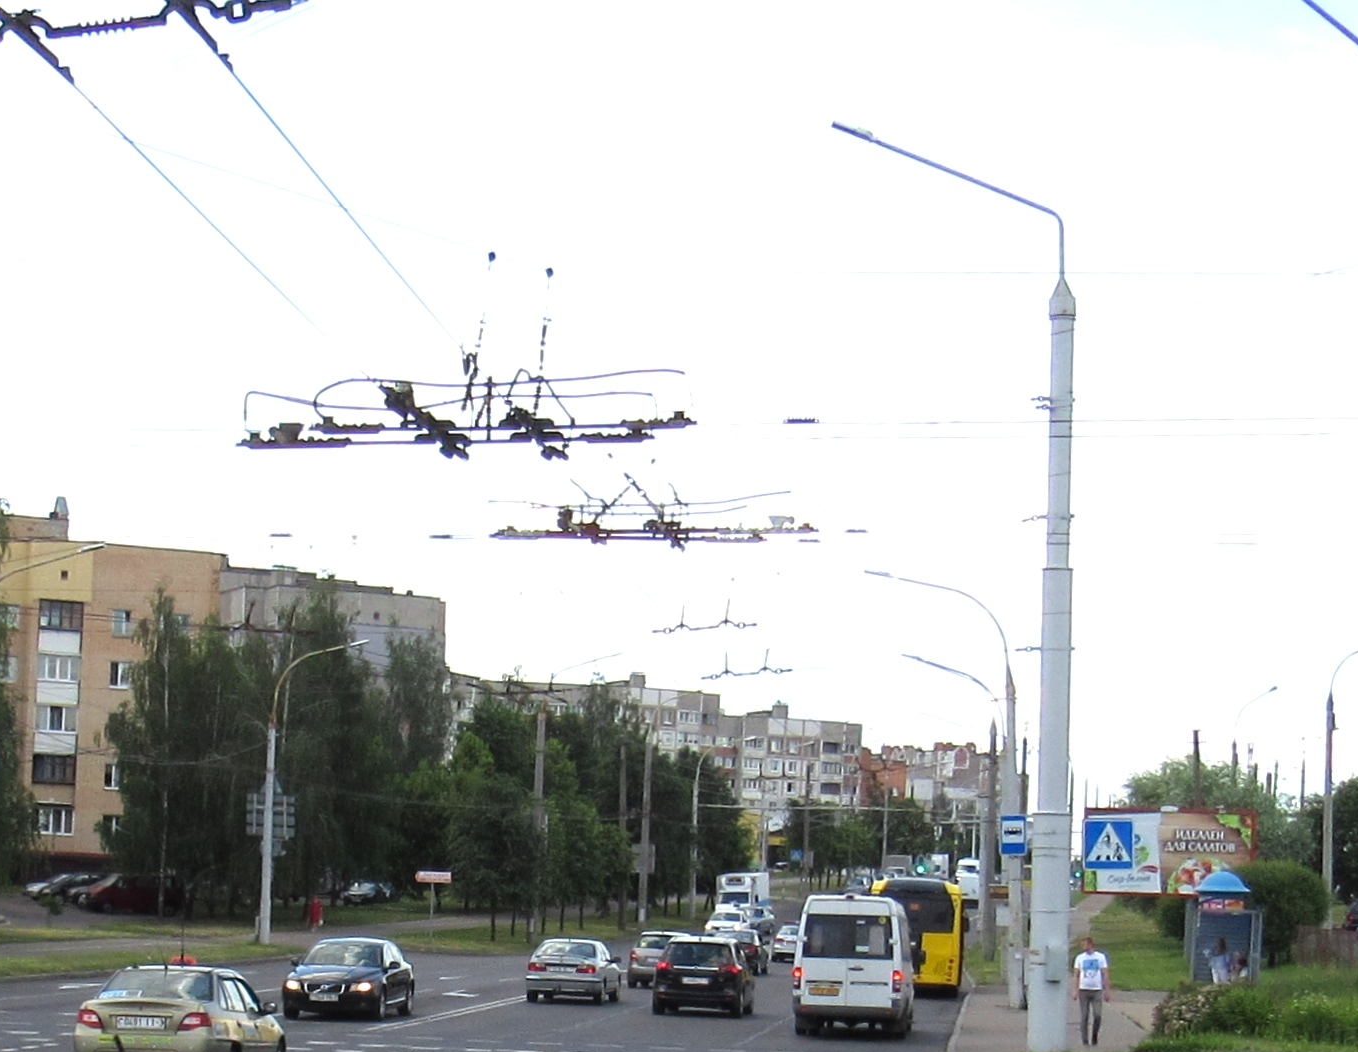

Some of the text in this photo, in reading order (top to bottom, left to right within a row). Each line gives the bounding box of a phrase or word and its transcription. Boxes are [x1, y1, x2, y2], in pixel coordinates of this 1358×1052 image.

[1175, 829, 1225, 841] ИДЕАЛЕН
[1164, 842, 1236, 853] ДЛЯ САЛАТОВ
